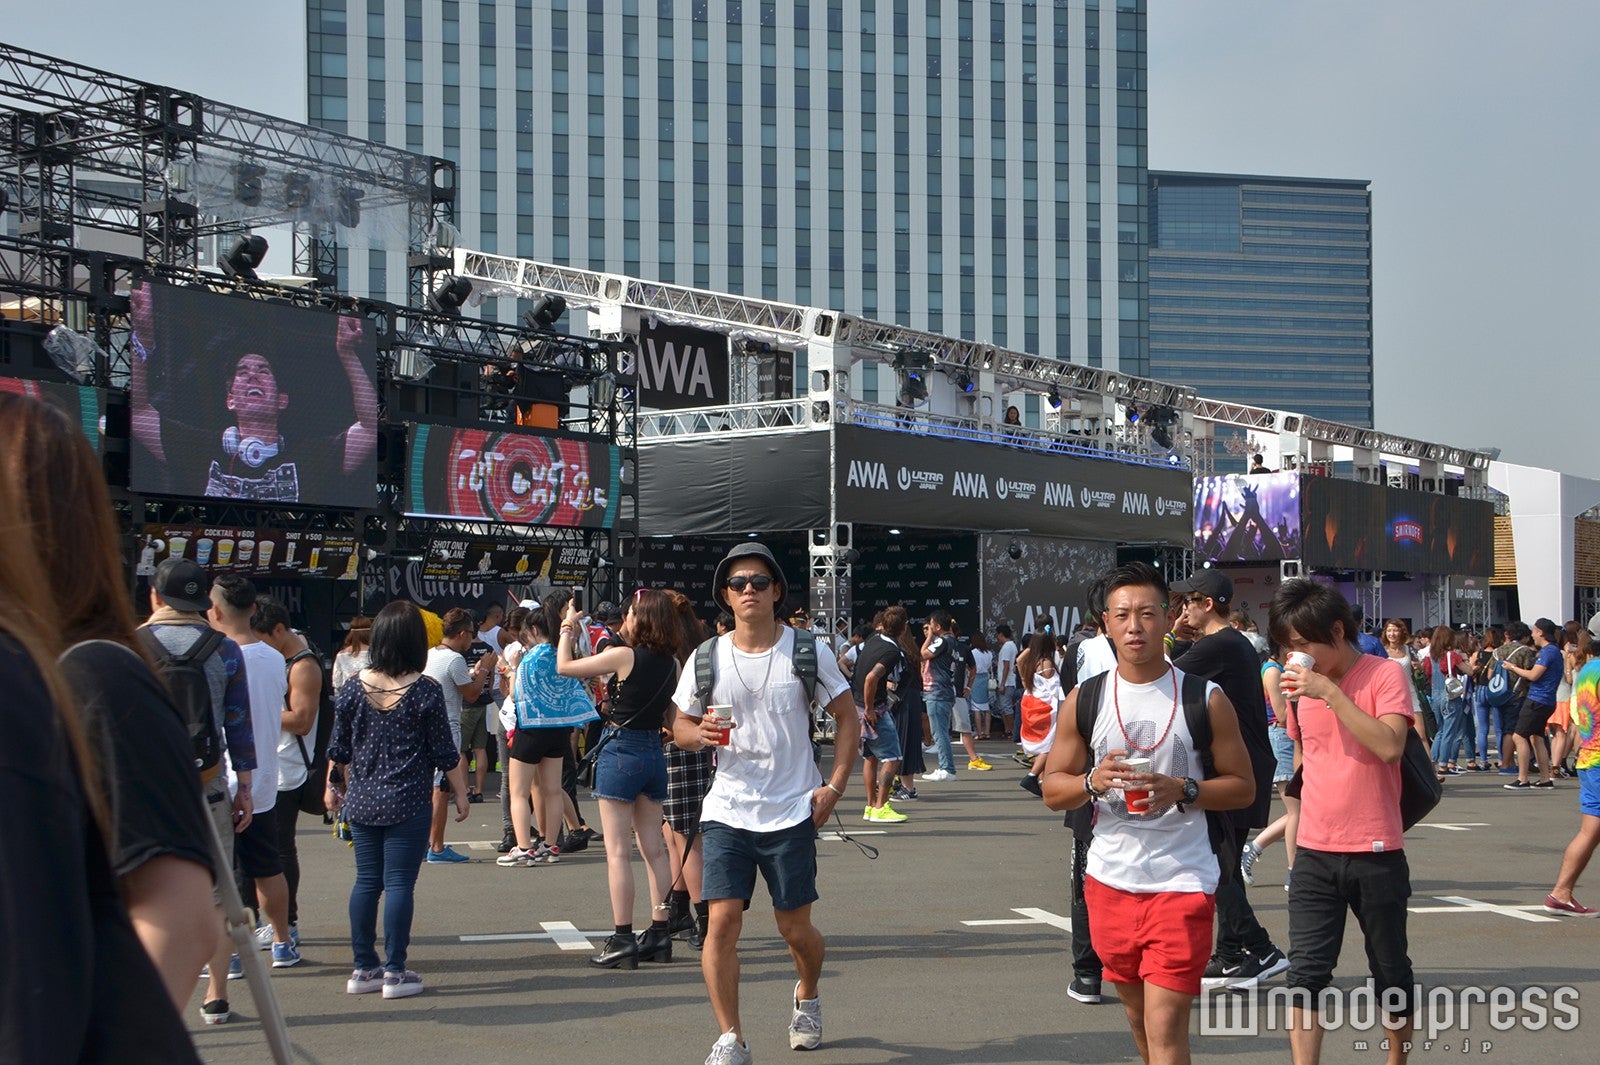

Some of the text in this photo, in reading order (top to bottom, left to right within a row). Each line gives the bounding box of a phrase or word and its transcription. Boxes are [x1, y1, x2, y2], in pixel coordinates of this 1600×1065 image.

[847, 460, 1187, 516] AWA ULTRA AWA ULTRA AWA ULTRA AWA ULTRA
[918, 483, 937, 491] JAPAN
[204, 529, 234, 537] COCKTAIL
[285, 532, 302, 540] SHOT
[1395, 524, 1421, 539] SMIRNOFF
[432, 540, 470, 550] SHOT ONLY
[496, 544, 510, 552] SHOT
[449, 549, 467, 559] LANE
[561, 547, 593, 558] SHOT ONLY
[558, 556, 591, 566] FAST LANE
[925, 562, 940, 570] AWA
[1456, 588, 1464, 599] VIP
